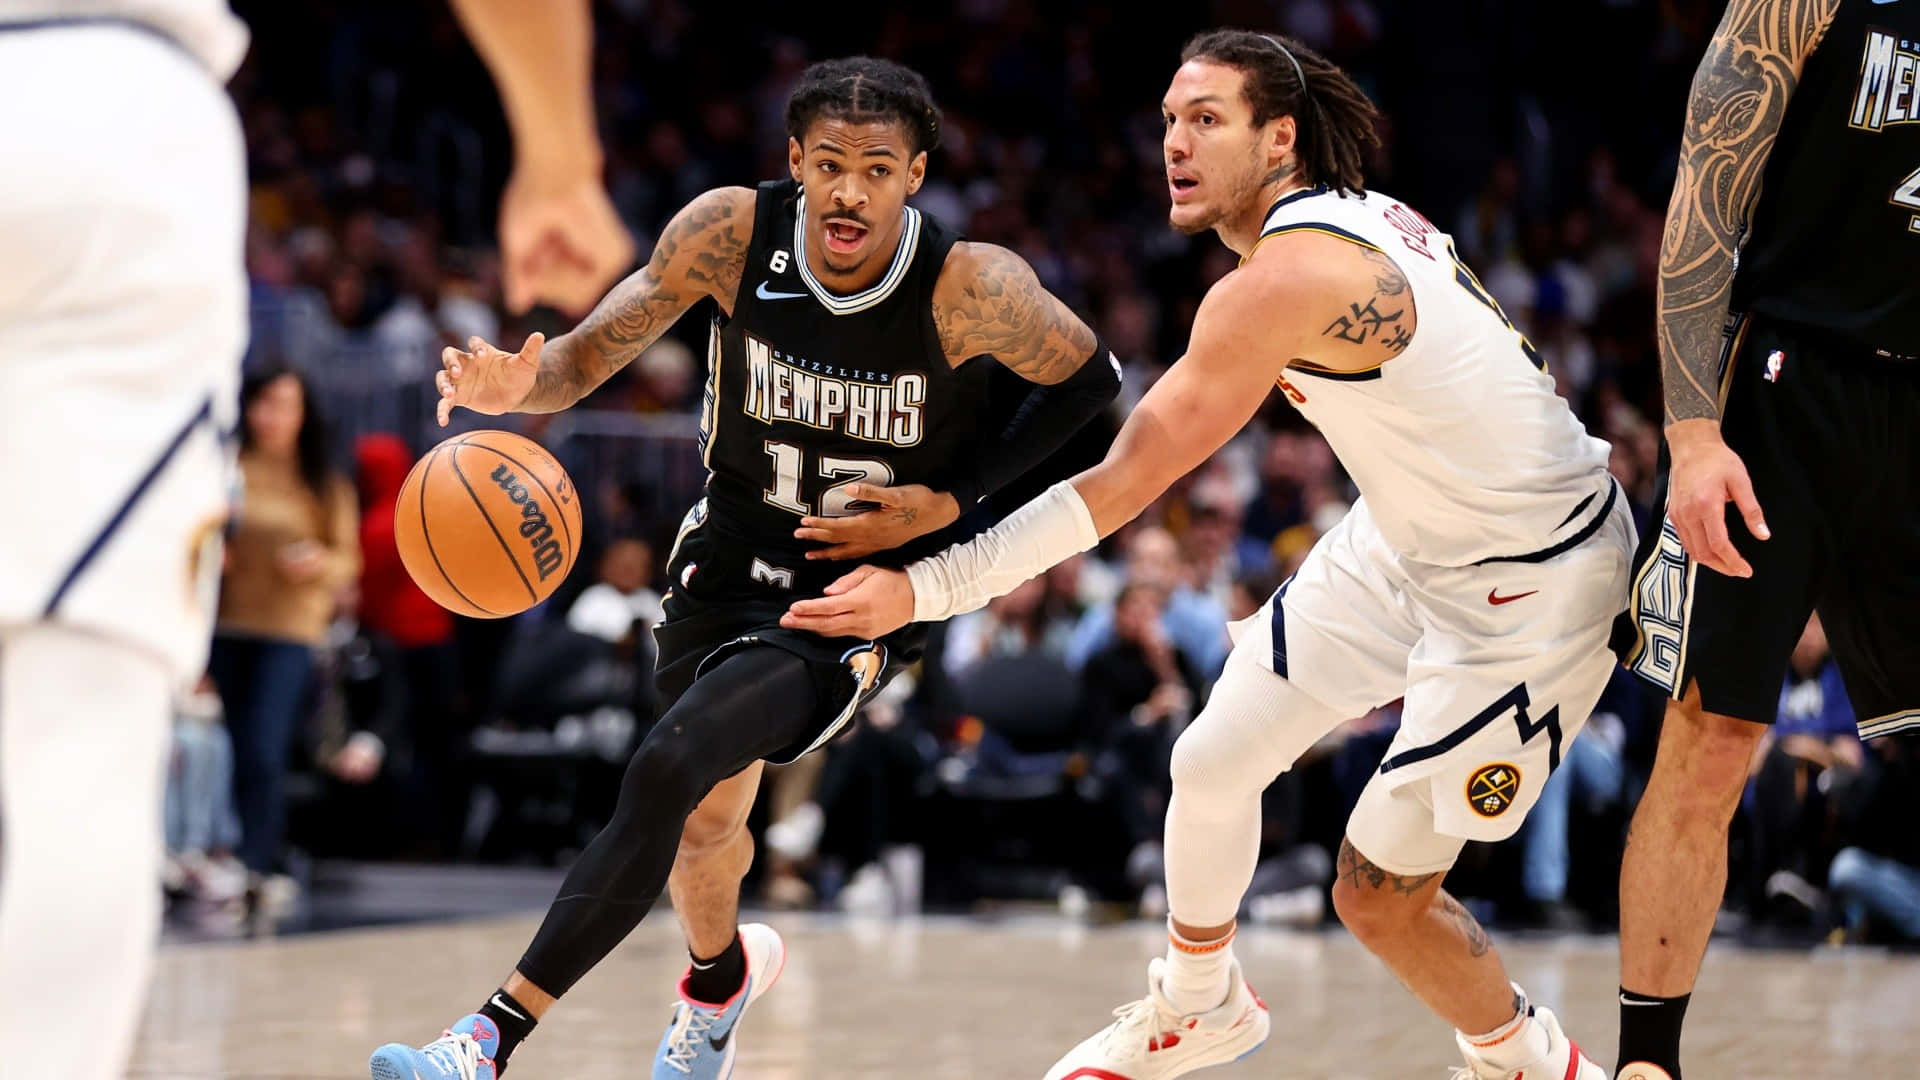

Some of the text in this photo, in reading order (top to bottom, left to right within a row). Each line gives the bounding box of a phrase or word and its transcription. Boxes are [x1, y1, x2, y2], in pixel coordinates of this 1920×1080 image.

[769, 249, 790, 274] 6
[744, 331, 927, 448] MEMPHIS
[774, 350, 889, 382] GRIZZLIES
[763, 440, 895, 517] 12
[490, 462, 564, 583] Wilson
